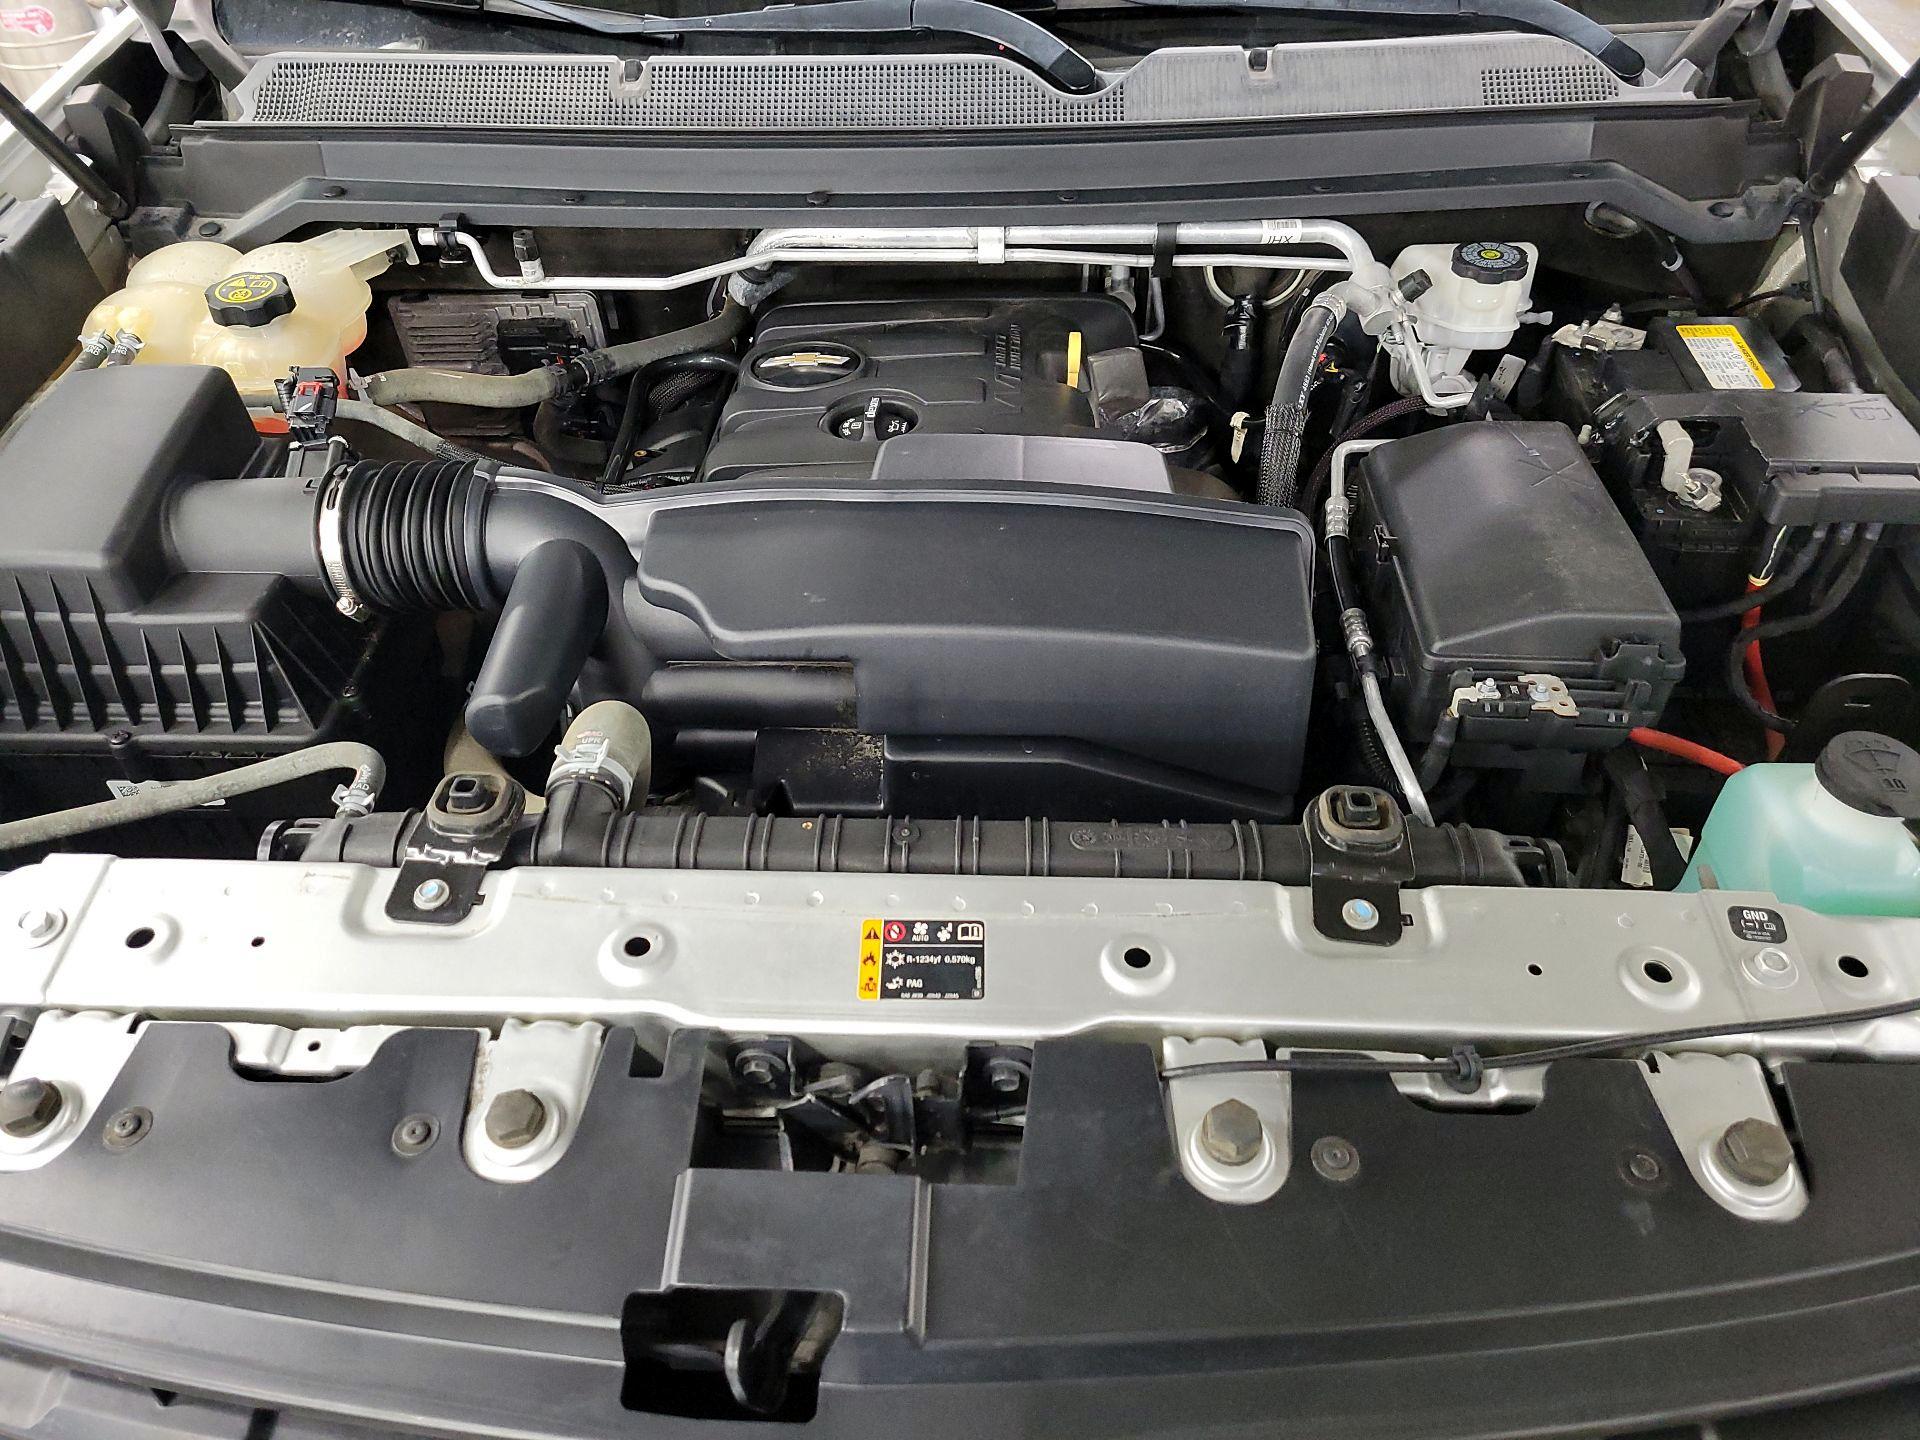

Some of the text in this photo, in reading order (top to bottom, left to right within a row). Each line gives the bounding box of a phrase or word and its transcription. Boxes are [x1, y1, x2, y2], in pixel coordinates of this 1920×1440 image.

[1742, 909, 1769, 921] GND
[912, 934, 930, 942] AUTO
[906, 954, 942, 965] R-1234yf
